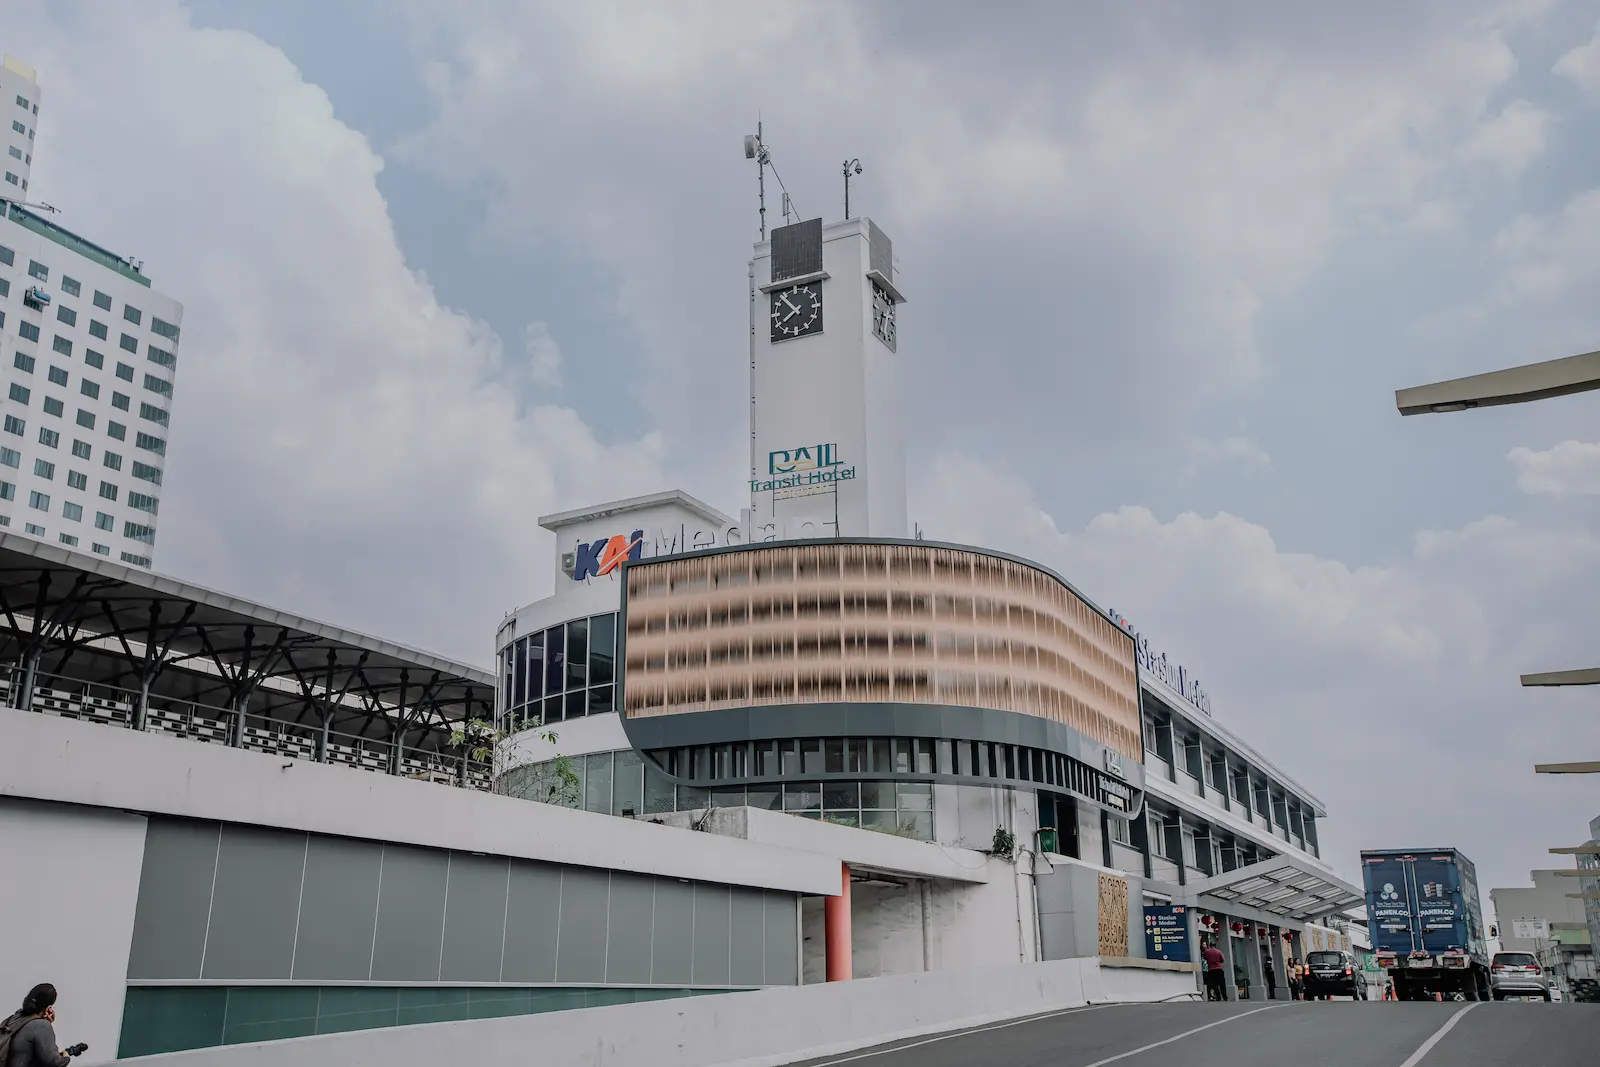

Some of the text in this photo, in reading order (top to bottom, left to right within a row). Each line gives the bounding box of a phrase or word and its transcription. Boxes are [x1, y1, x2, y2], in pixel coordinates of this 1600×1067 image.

[769, 443, 844, 475] RAIL
[749, 473, 803, 492] Transit
[809, 466, 856, 485] Hotel
[574, 530, 643, 580] KAI
[1420, 909, 1454, 917] PANEN.CO
